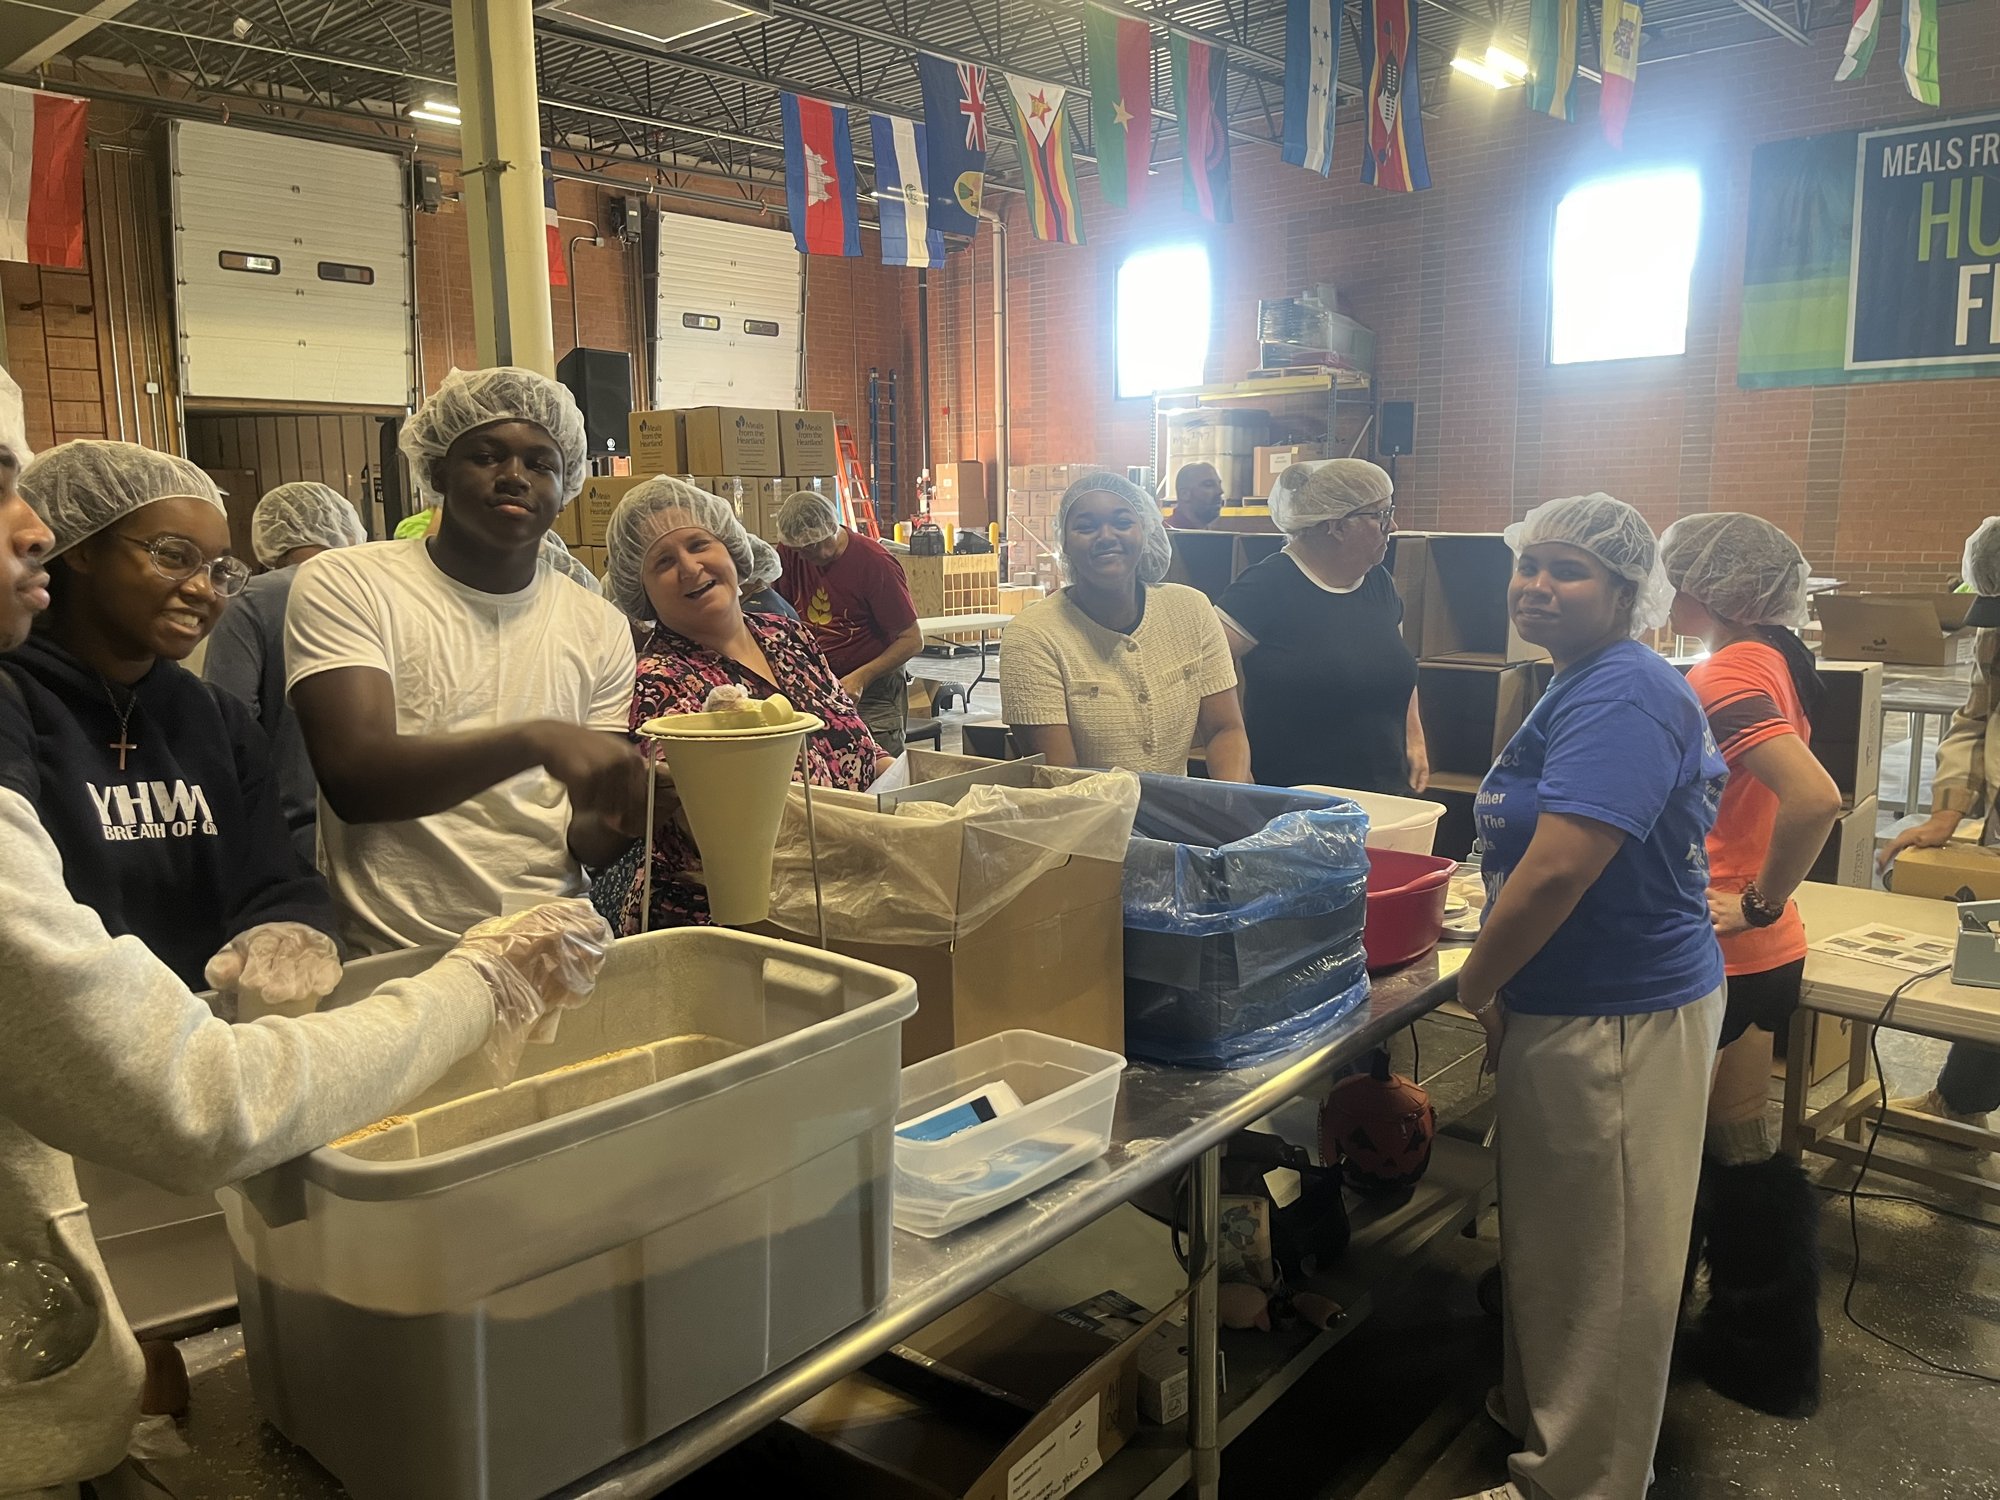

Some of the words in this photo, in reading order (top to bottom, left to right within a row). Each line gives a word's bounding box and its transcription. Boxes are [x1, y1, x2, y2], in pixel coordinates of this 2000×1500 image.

[1882, 137, 1963, 178] MEALS
[1969, 133, 2000, 168] FR
[1918, 176, 2000, 262] HU
[746, 421, 764, 429] Meals
[804, 423, 822, 431] Meals
[738, 429, 753, 437] from
[754, 430, 765, 438] the
[737, 437, 766, 445] Heartland
[1483, 814, 1506, 829] The
[102, 823, 167, 841] BREATH
[171, 820, 197, 837] OF
